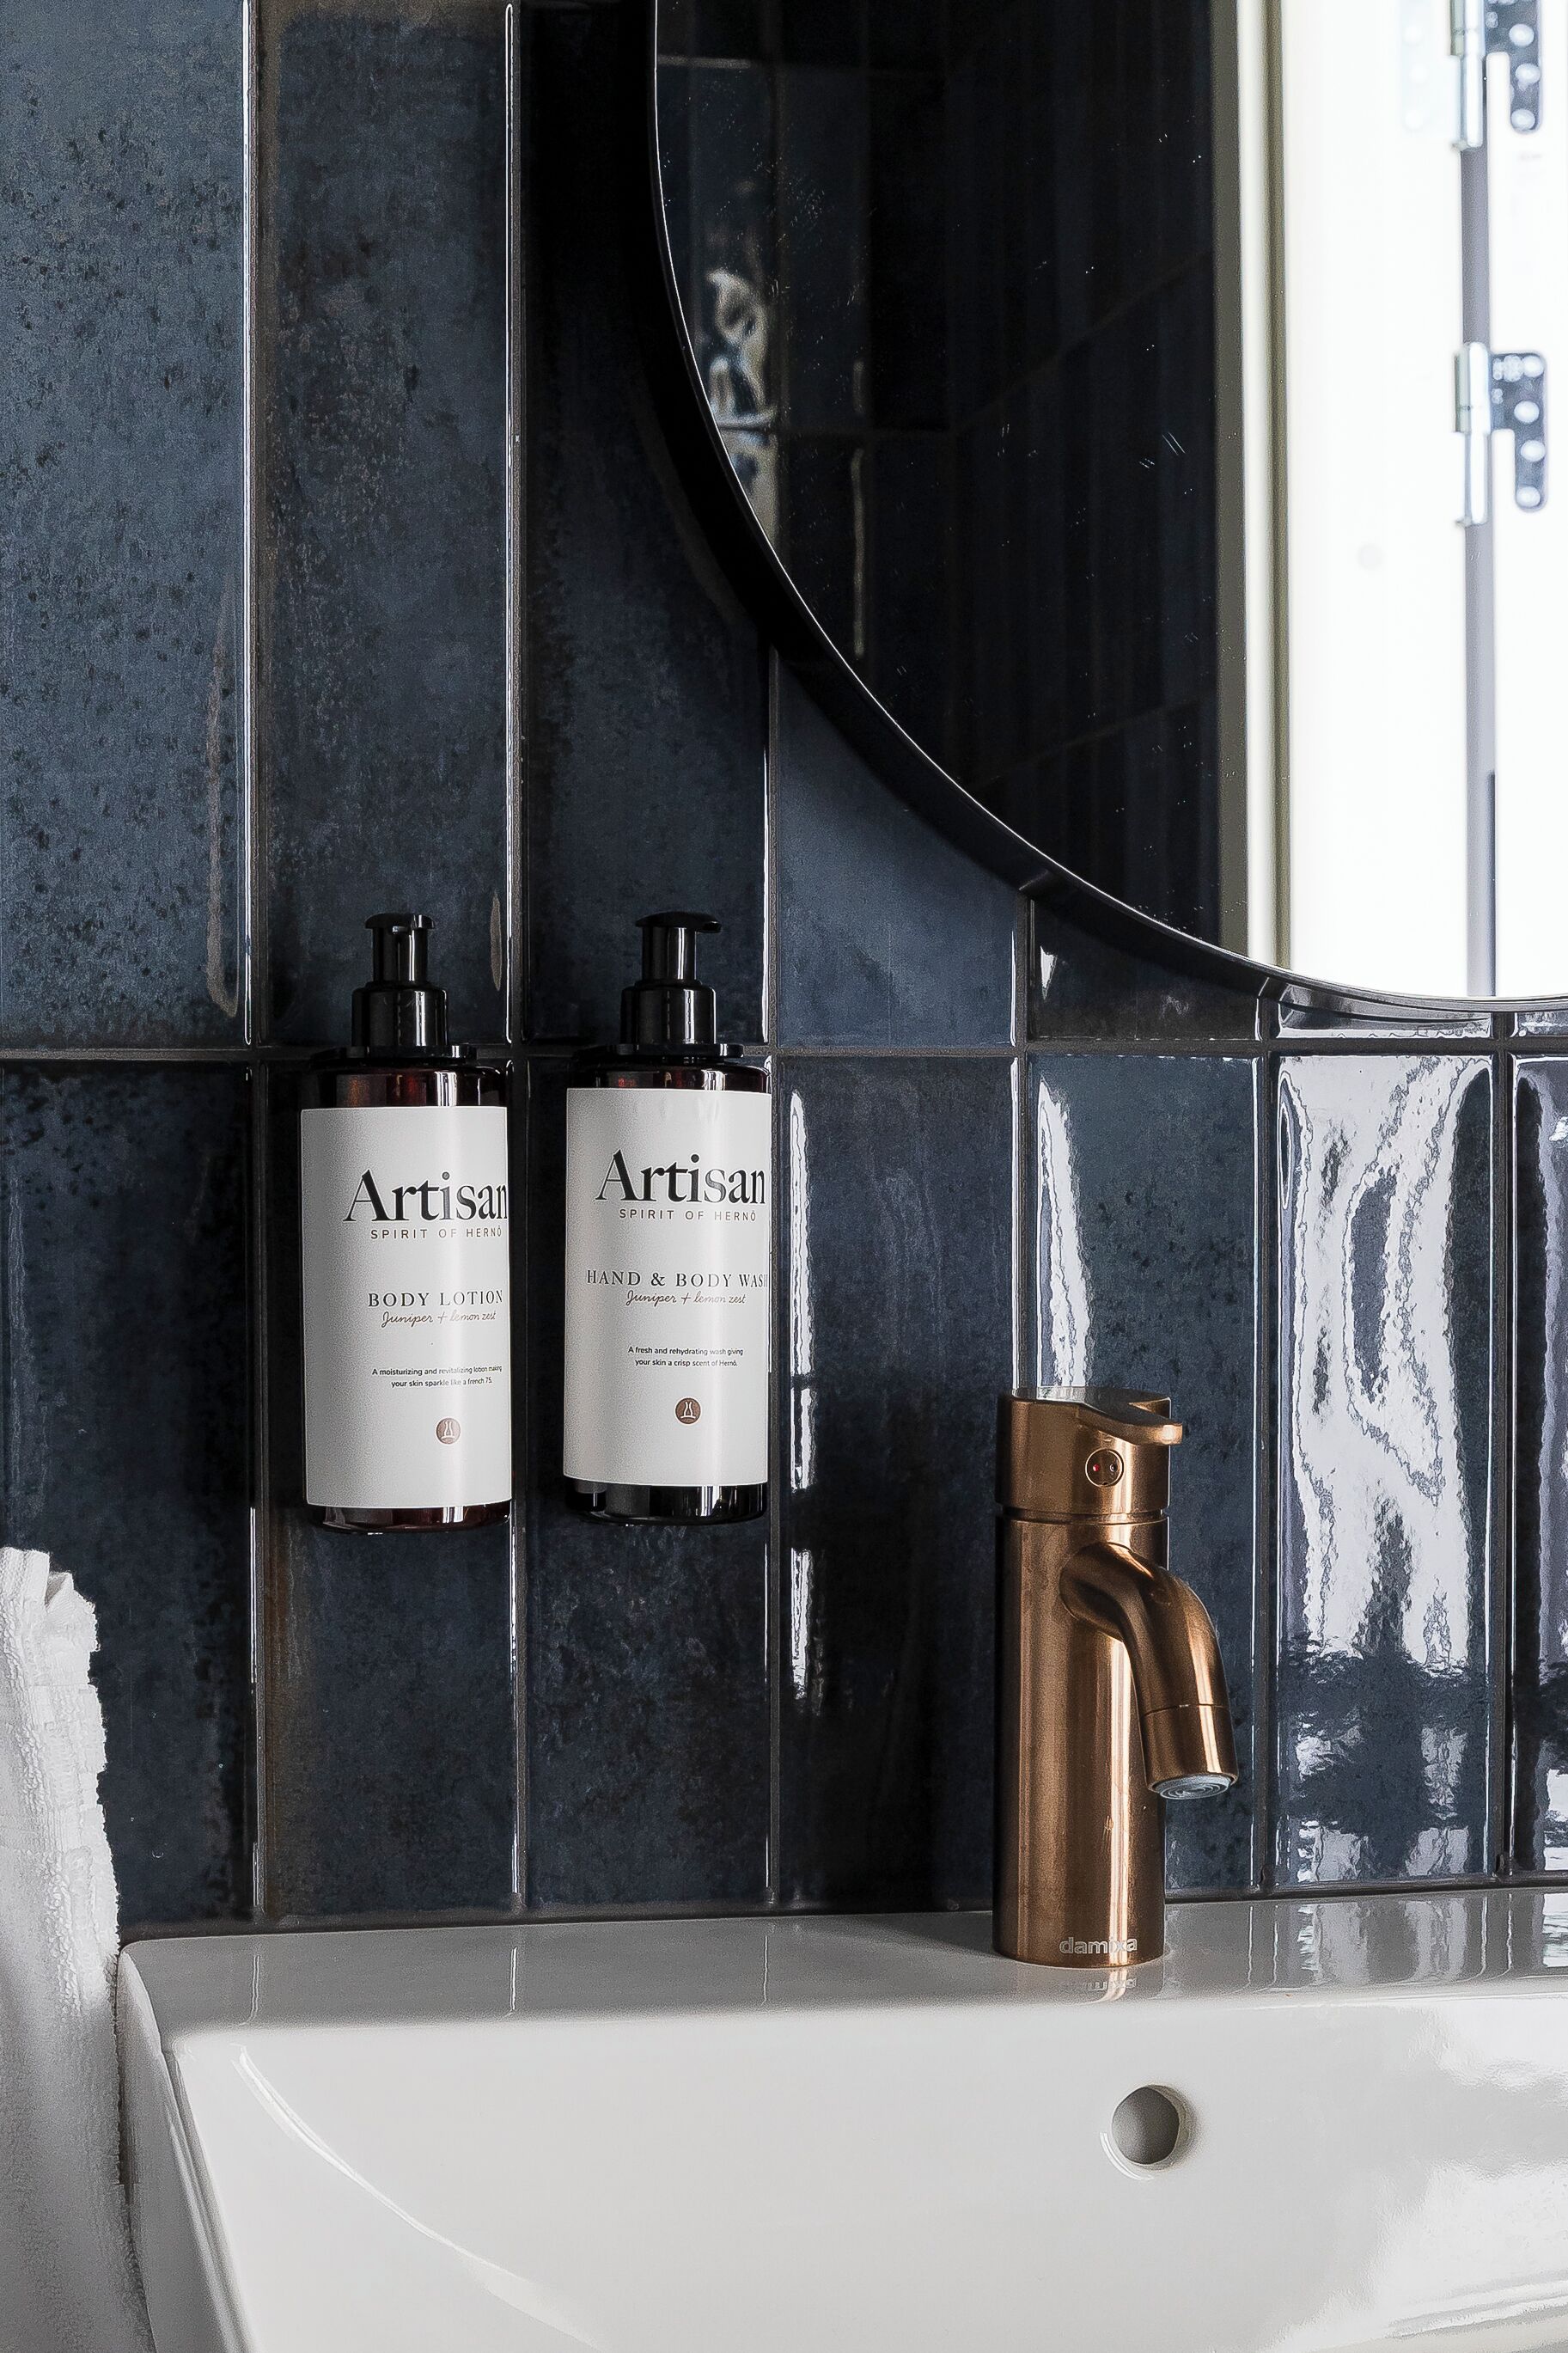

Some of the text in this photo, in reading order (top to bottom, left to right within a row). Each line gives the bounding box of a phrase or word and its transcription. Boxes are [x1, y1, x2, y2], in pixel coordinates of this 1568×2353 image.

[595, 1149, 766, 1204] Artisan
[343, 1169, 509, 1221] Artisan
[619, 1209, 674, 1220] SPIRIT
[685, 1210, 704, 1220] OF
[371, 1229, 428, 1239] SPIRIT
[438, 1228, 457, 1238] OF
[587, 1269, 641, 1286] HAND
[650, 1272, 665, 1287] &
[675, 1273, 732, 1287] BODY
[368, 1290, 503, 1307] BODY LOTION
[625, 1290, 746, 1307] Juniper + lemon zest
[381, 1311, 433, 1329] Juniper
[449, 1309, 479, 1322] lemon
[379, 1367, 423, 1377] moisturizing
[408, 1378, 423, 1387] skin
[424, 1378, 449, 1388] sparkle
[1059, 1936, 1138, 1954] damixa
